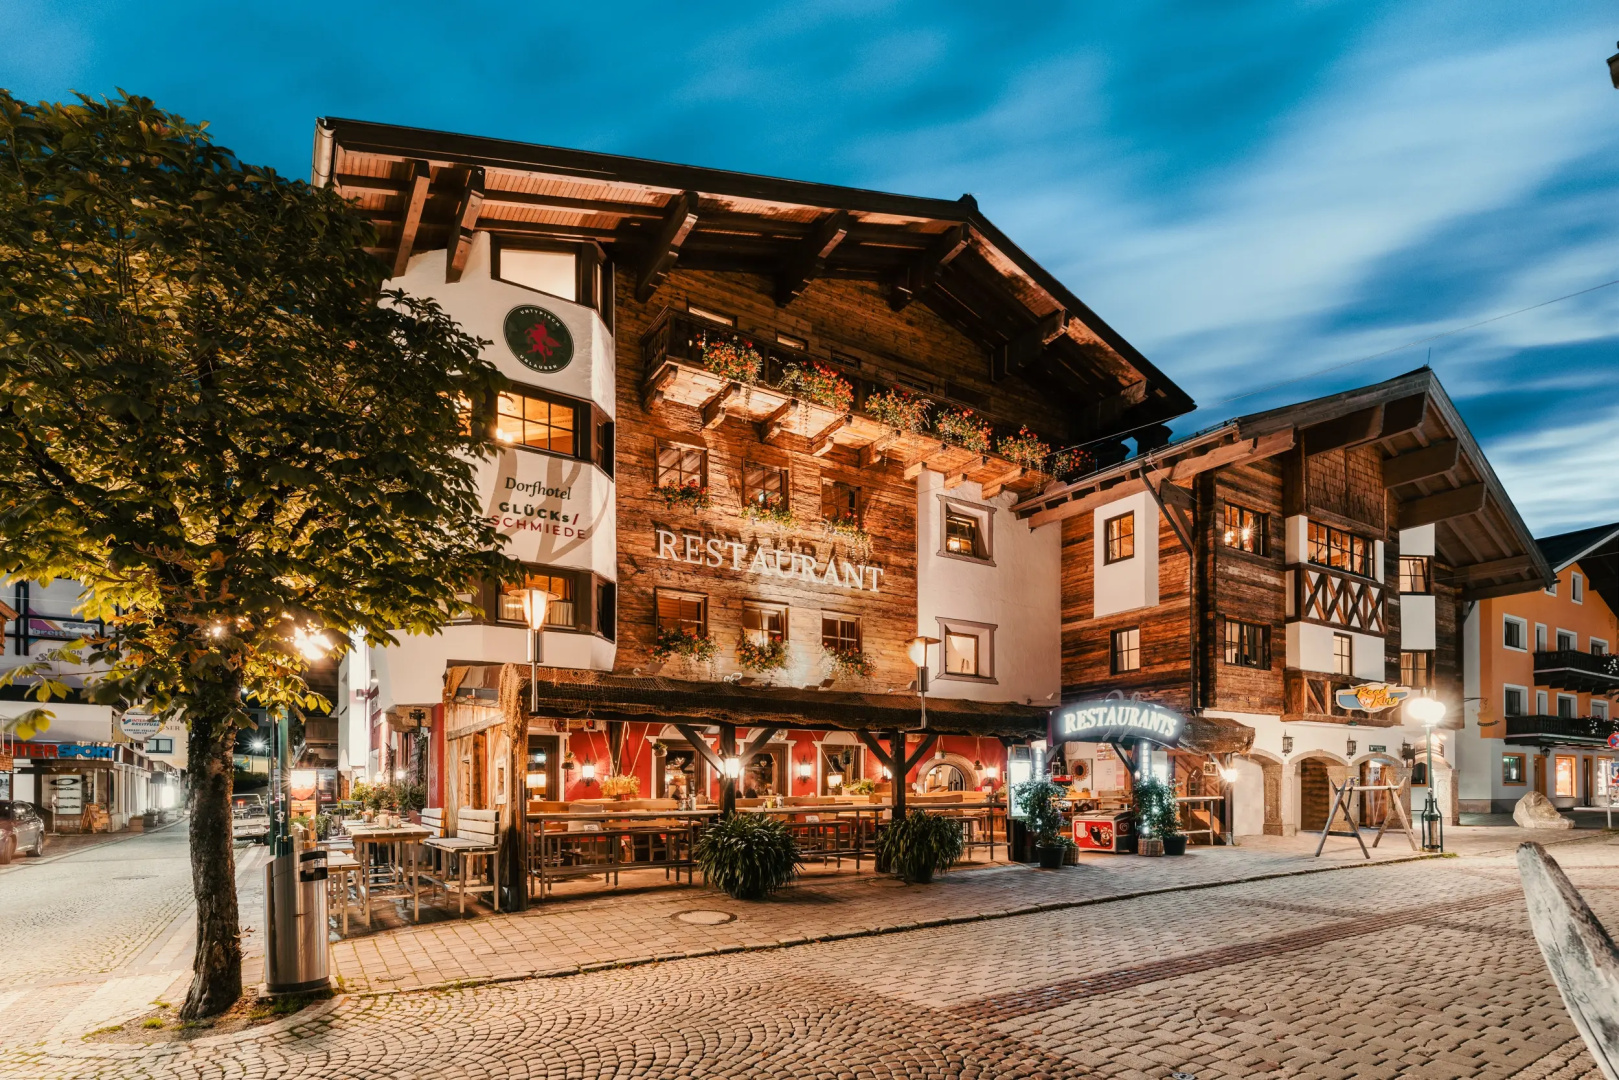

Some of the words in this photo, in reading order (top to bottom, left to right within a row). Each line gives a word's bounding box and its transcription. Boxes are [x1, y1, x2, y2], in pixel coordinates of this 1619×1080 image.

[505, 477, 571, 500] Dorfhotel
[491, 515, 586, 539] SCHMIEDE
[656, 529, 884, 592] RESTAURANT
[1354, 685, 1389, 699] Road
[1370, 694, 1399, 708] King
[1064, 706, 1177, 737] RESTAURANTS
